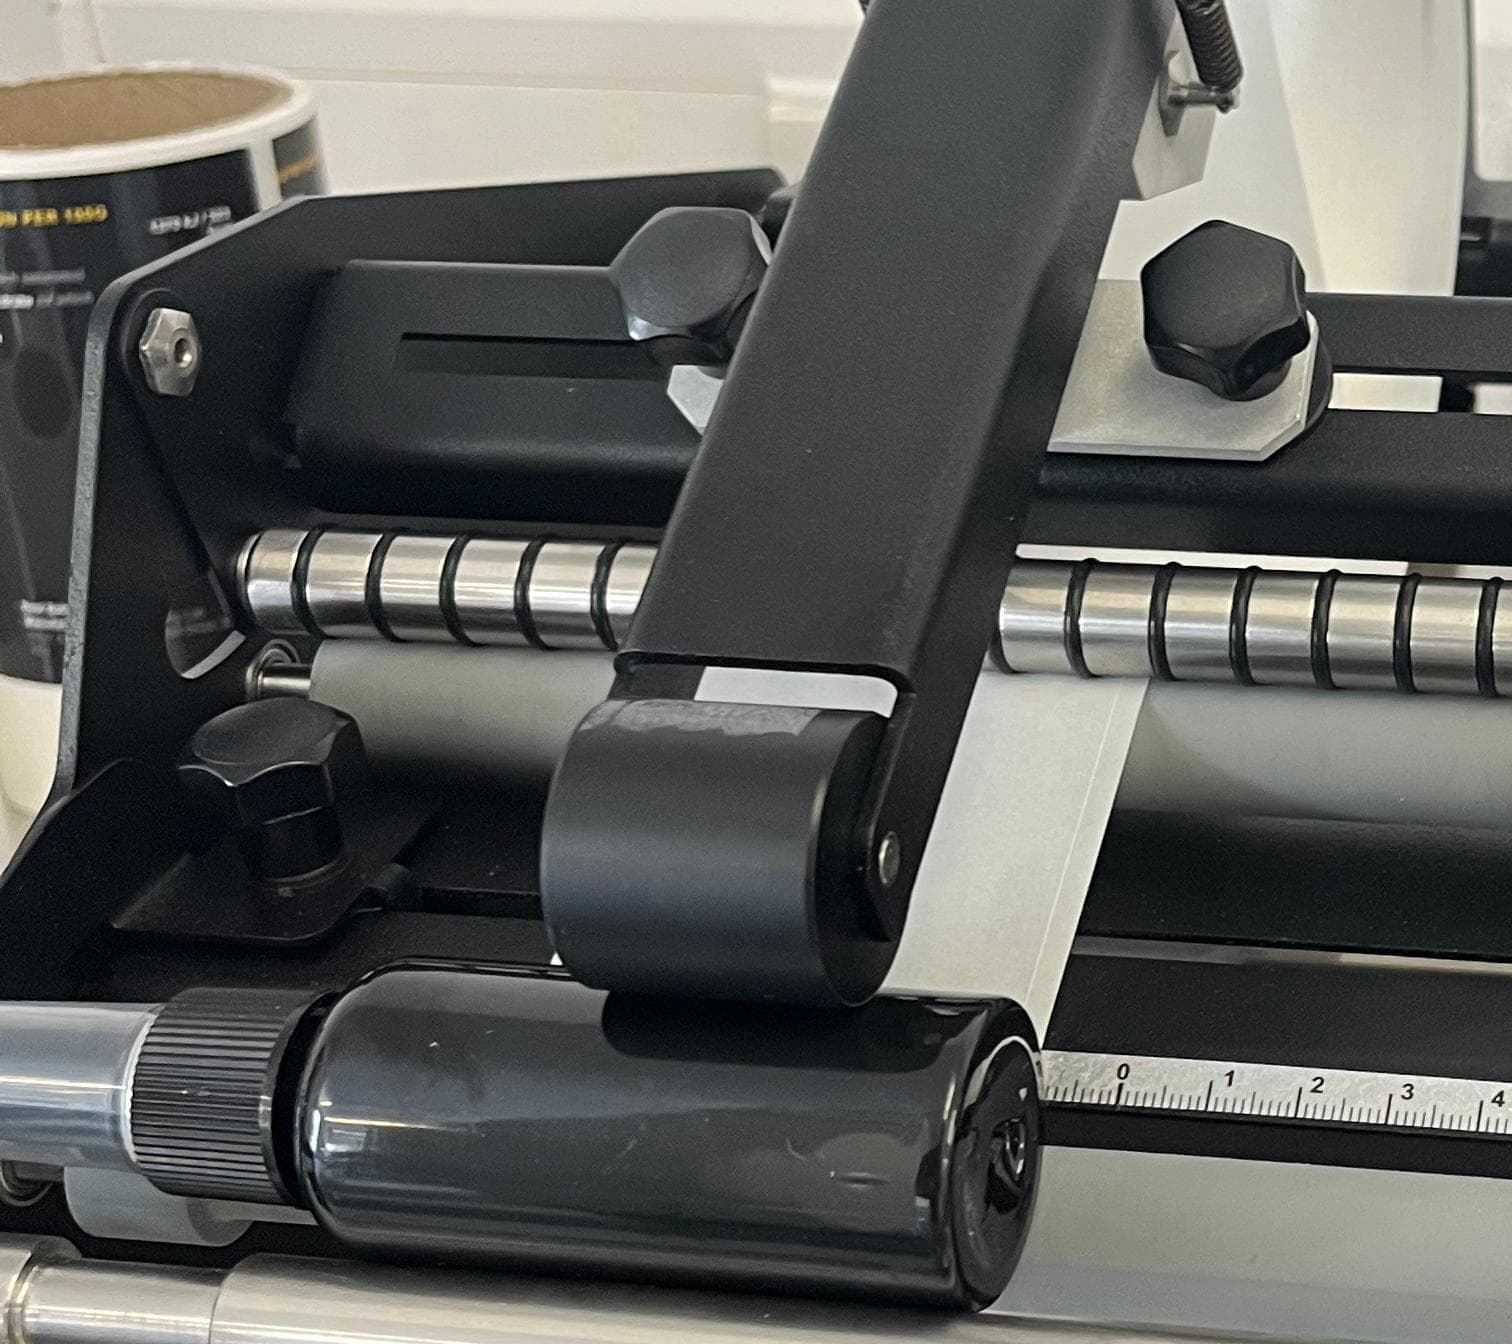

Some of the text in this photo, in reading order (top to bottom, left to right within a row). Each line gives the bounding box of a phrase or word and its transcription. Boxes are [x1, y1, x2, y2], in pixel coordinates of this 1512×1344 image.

[1116, 1063, 1130, 1080] 0
[1224, 1069, 1235, 1087] 1
[1310, 1076, 1325, 1094] 2
[1400, 1083, 1415, 1100] 3
[1491, 1090, 1506, 1107] 4
